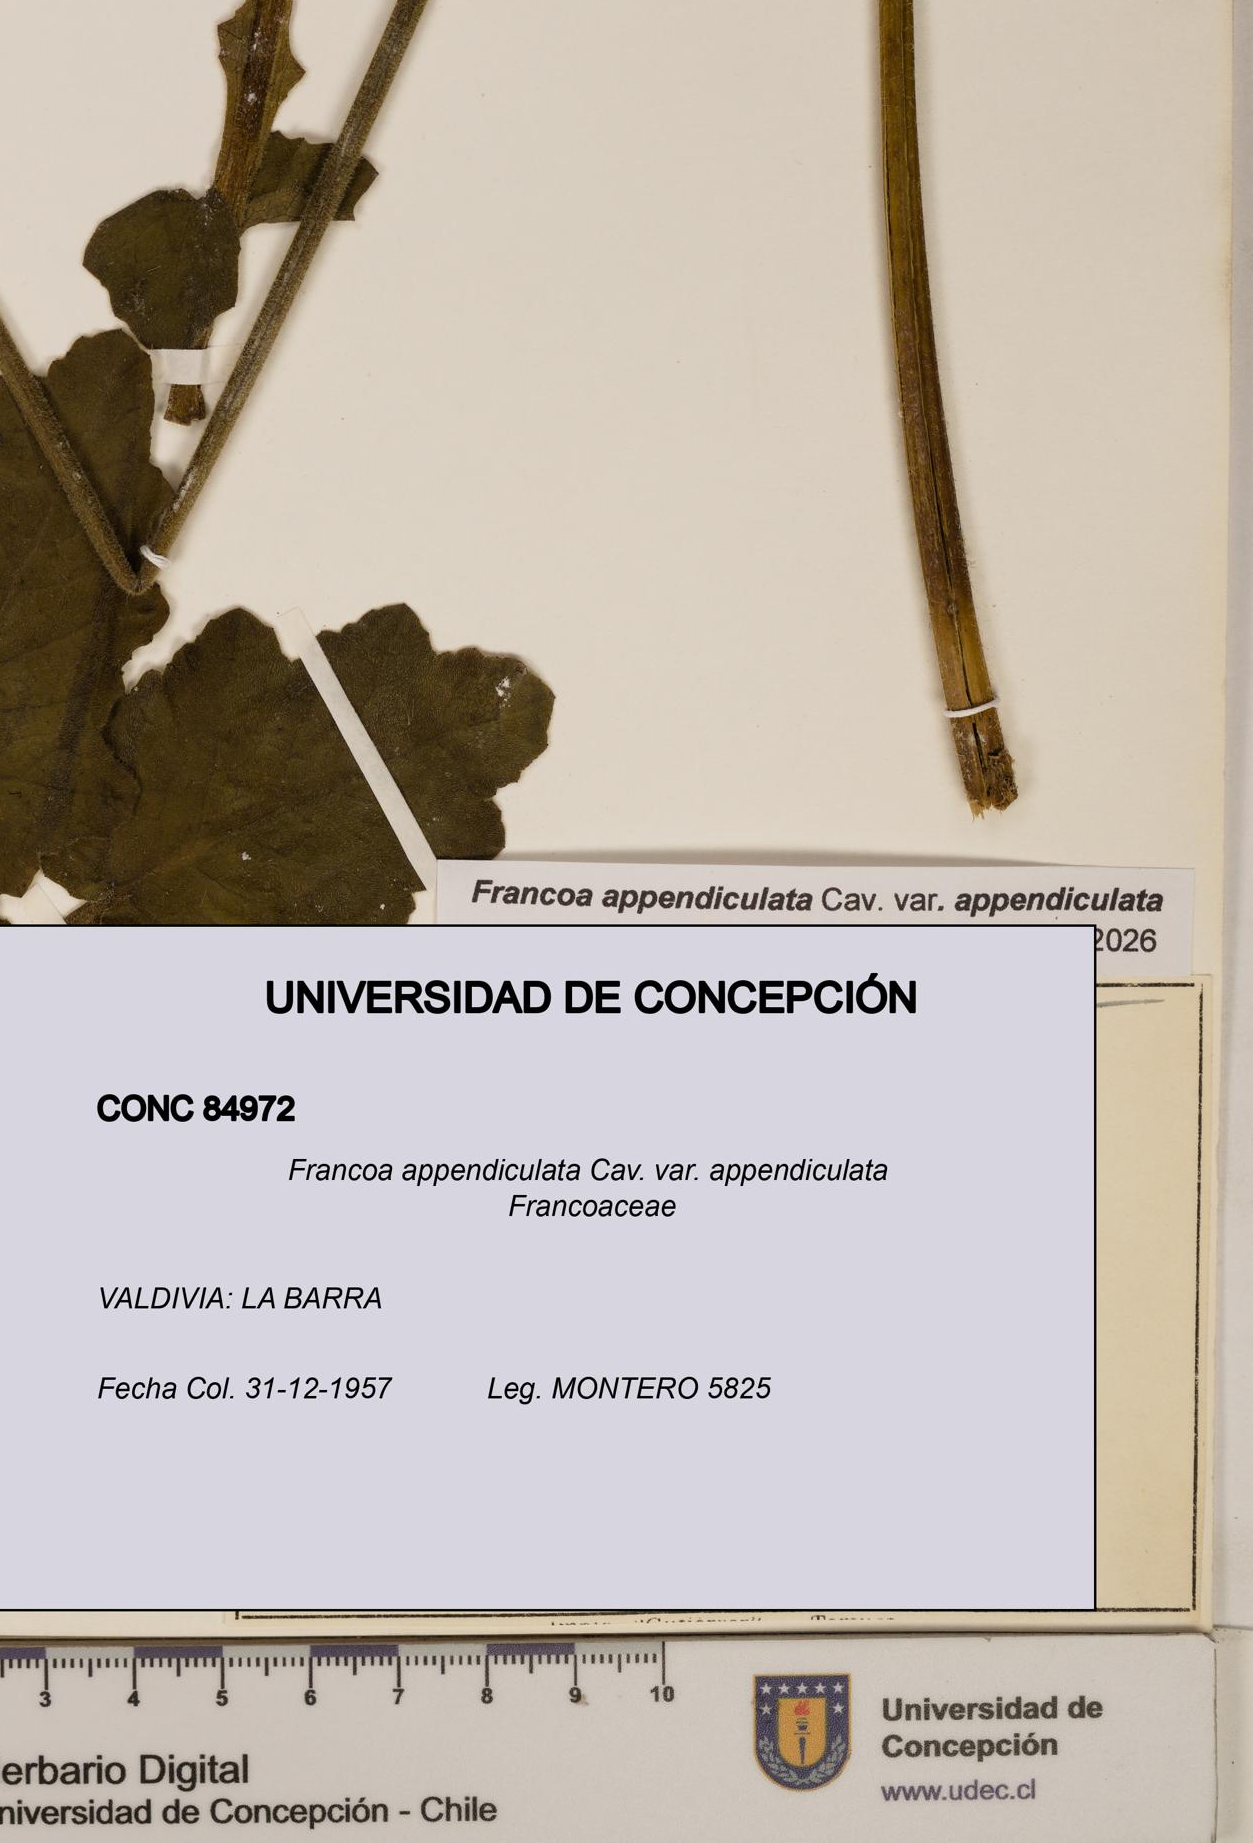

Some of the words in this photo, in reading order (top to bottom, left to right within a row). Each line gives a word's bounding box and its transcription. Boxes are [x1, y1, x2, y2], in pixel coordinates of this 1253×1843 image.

[471, 879, 593, 908] Francoa
[601, 886, 813, 913] appendiculata
[821, 887, 884, 912] Cav.
[894, 893, 945, 913] var.
[954, 887, 1164, 917] appendiculata
[39, 1691, 52, 1708] 3
[127, 1690, 141, 1707] 4
[215, 1690, 229, 1707] 5
[304, 1689, 317, 1706] 6
[392, 1688, 405, 1705] 7
[480, 1688, 494, 1705] 8
[568, 1687, 583, 1704] 9
[650, 1685, 675, 1703] 10
[882, 1695, 1058, 1722] Universidad
[1067, 1695, 1104, 1720] de
[881, 1731, 1058, 1763] Concepción
[139, 1753, 249, 1793] Digital
[880, 1777, 1036, 1802] www.udec.cl
[161, 1799, 200, 1825] de
[209, 1796, 389, 1830] Concepción
[420, 1795, 498, 1824] Chile
